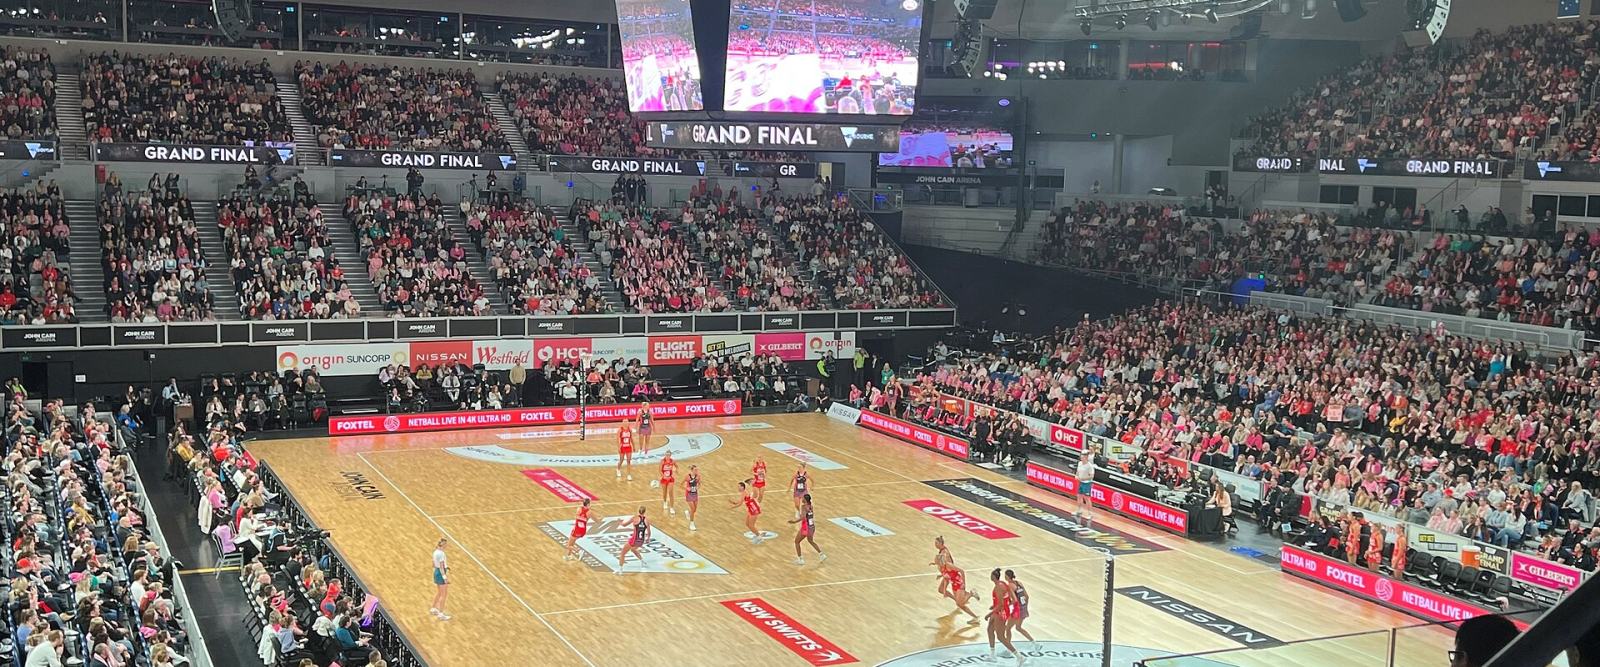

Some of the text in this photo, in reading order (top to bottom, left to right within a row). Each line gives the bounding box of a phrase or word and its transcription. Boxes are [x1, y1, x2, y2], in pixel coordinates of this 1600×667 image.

[692, 126, 817, 145] GRAND FINAL
[145, 147, 258, 162] GRAND FINAL
[381, 153, 482, 167] GRAND FINAL
[592, 159, 682, 173] GRAND FINAL
[1257, 158, 1292, 169] GRAND
[1406, 161, 1493, 174] GRAND FINAL
[654, 341, 695, 351] FLIGHT
[768, 343, 803, 351] GILBERT
[825, 340, 851, 351] origin
[346, 354, 390, 363] SUNCORP
[416, 353, 467, 361] NISSAN
[477, 346, 530, 365] Westfield
[556, 347, 588, 359] HCF
[653, 350, 696, 360] CENTRE
[302, 355, 344, 369] origin
[337, 420, 375, 430] FOXTEL
[408, 417, 440, 426] NETBALL
[441, 416, 457, 425] LIVE
[458, 416, 466, 424] IN
[467, 415, 476, 423] 4K
[478, 414, 500, 423] ULTRA
[501, 414, 511, 422] HD
[521, 412, 555, 421] FOXTEL
[585, 409, 613, 418] NETBALL
[614, 408, 628, 416] LIVE
[629, 408, 636, 416] IN
[686, 405, 716, 413] FOXTEL
[832, 407, 857, 419] NISSAN
[914, 430, 933, 443] FOXTEL
[949, 442, 966, 454] NETBALL
[1063, 432, 1079, 444] HCF
[1027, 467, 1184, 527] LIVE IN 4K ULTRA HD TEL NETBALL LIVE IN 4K
[947, 512, 997, 534] HCF
[1479, 552, 1504, 564] GRAND
[1479, 560, 1502, 572] FINAL
[1529, 565, 1575, 586] GILBERT
[1281, 551, 1304, 568] ULTRA
[1305, 559, 1316, 571] HD
[1326, 565, 1365, 588] FOXTEL
[1402, 590, 1440, 613] NETBALL
[1441, 603, 1461, 620] LIVE
[1130, 589, 1267, 643] NISSAN
[736, 601, 823, 651] NSW SWIFTS
